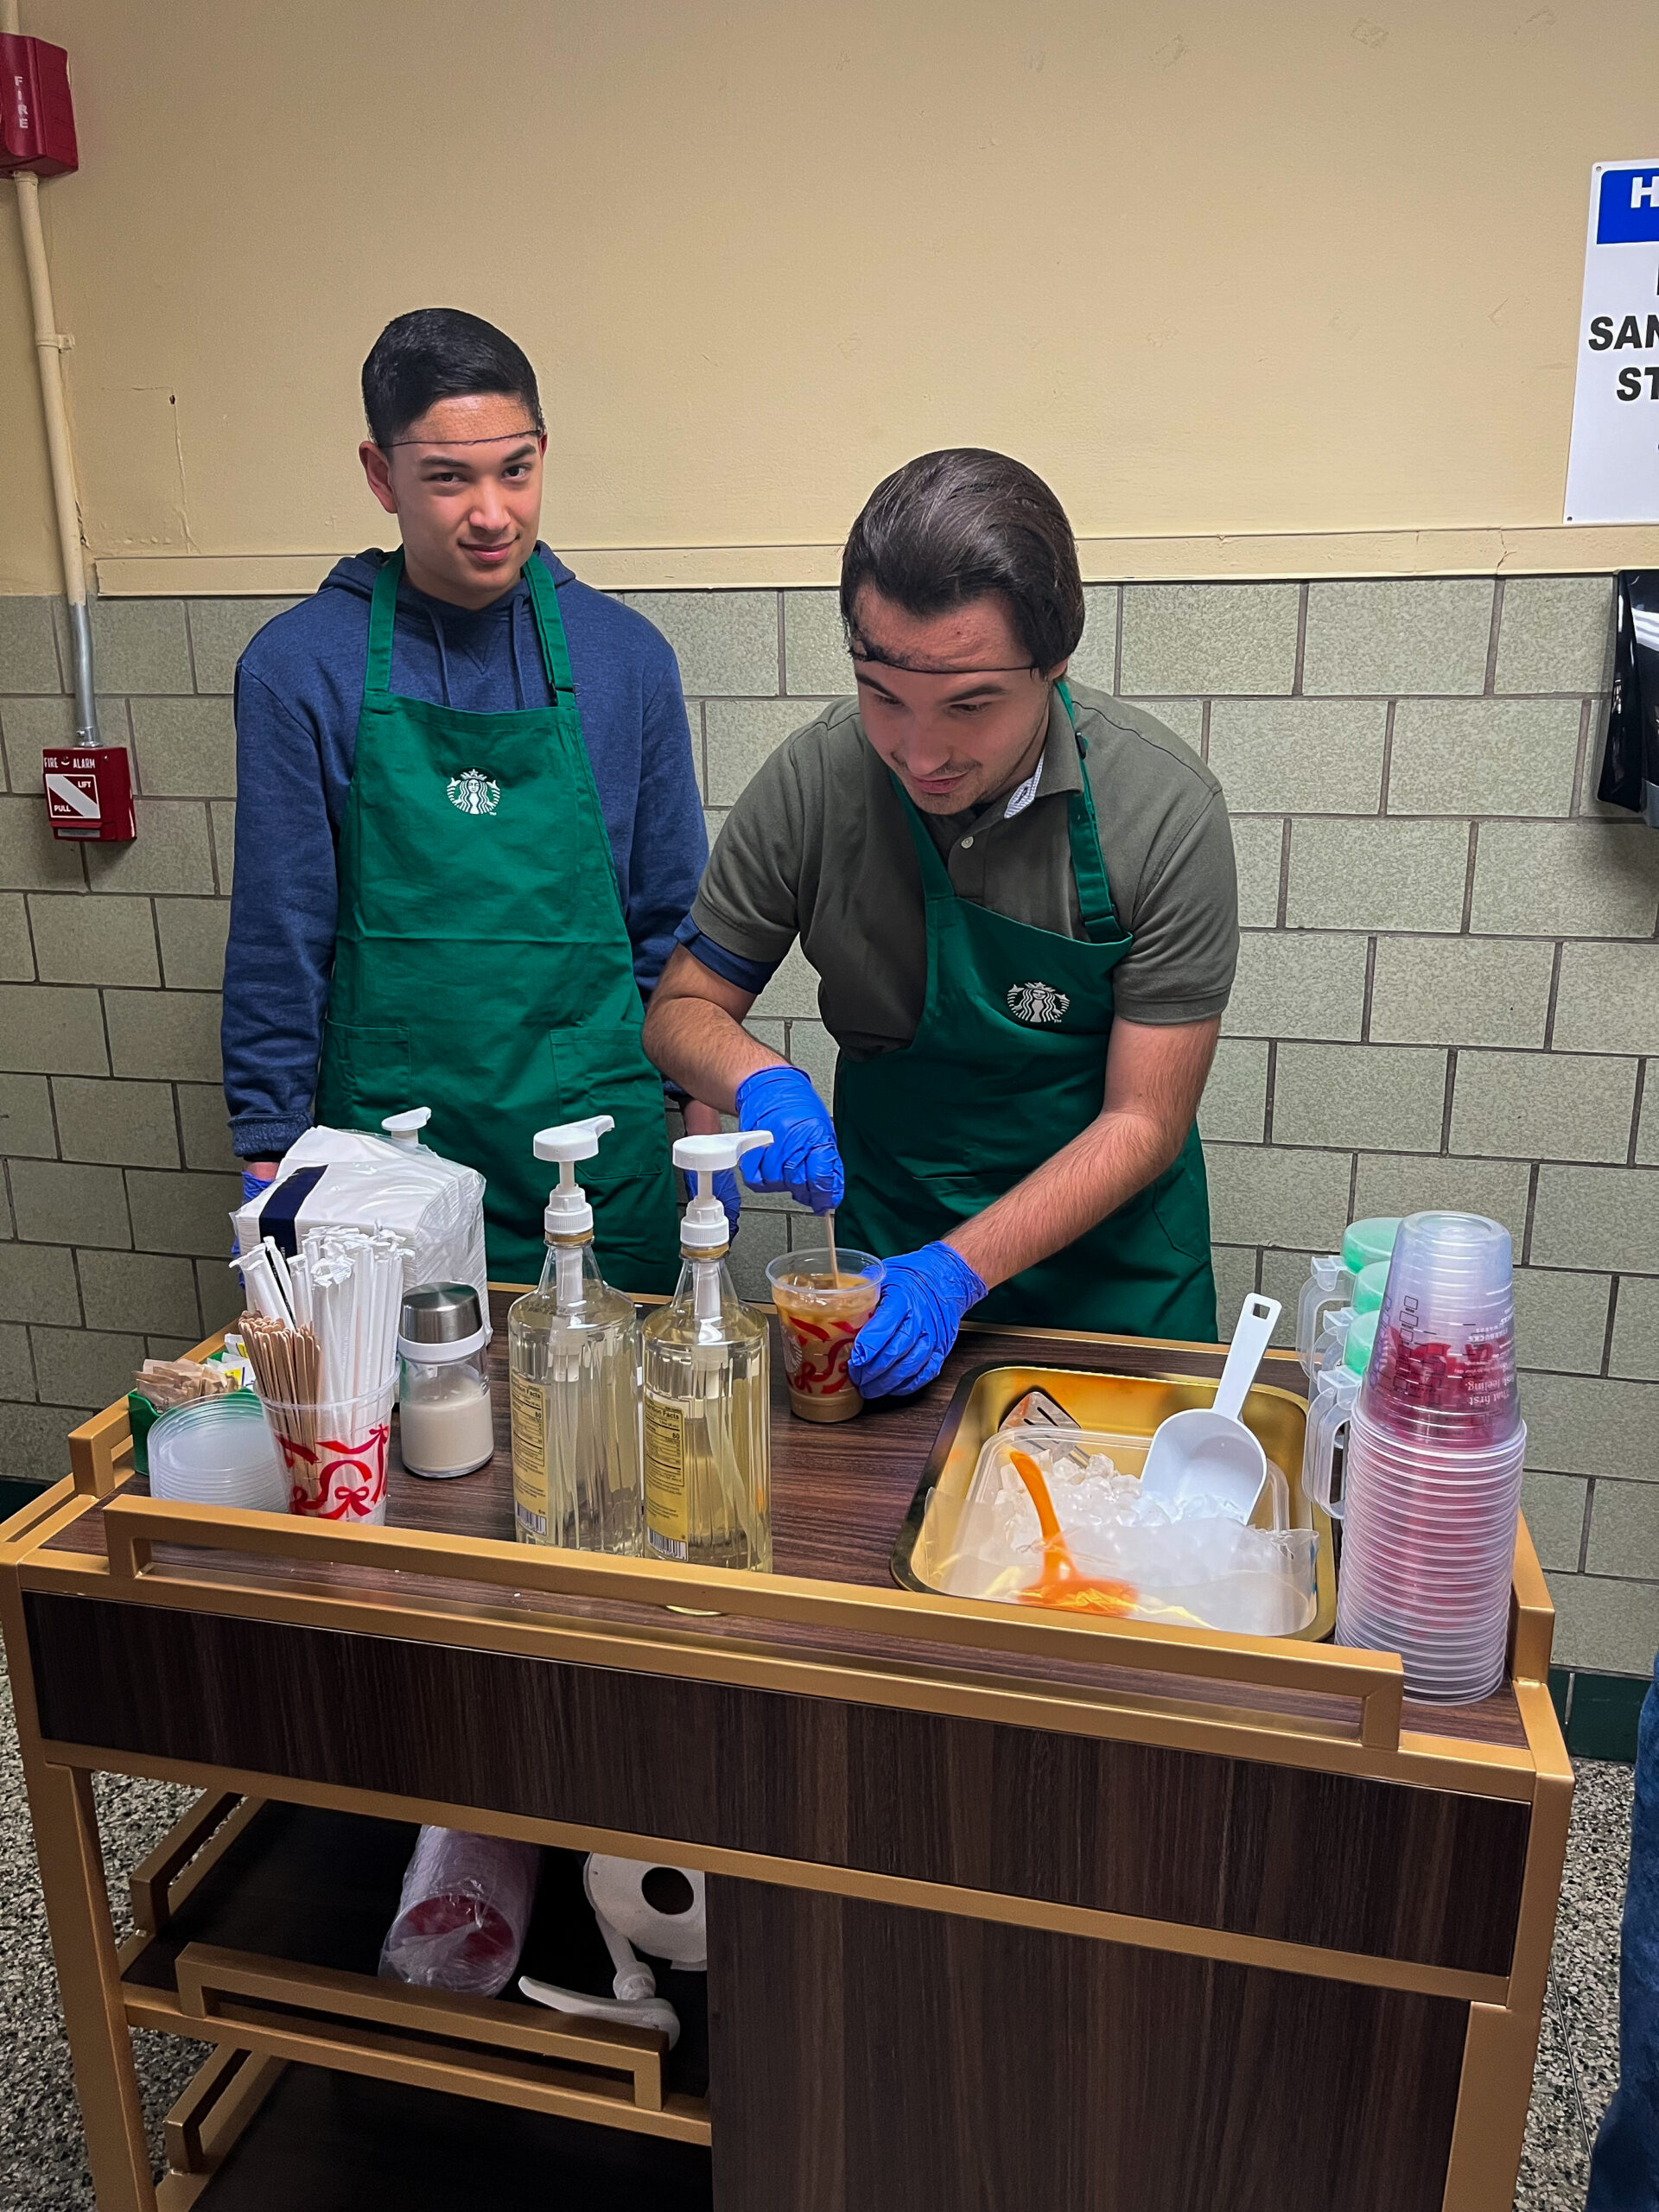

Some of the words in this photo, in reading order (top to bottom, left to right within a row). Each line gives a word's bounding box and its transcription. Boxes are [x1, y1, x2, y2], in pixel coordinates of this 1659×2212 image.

[14, 75, 29, 129] FIRE
[44, 757, 59, 768] FIRE
[73, 758, 96, 769] ALARM
[1469, 1394, 1491, 1406] first
[663, 1410, 680, 1420] Facts
